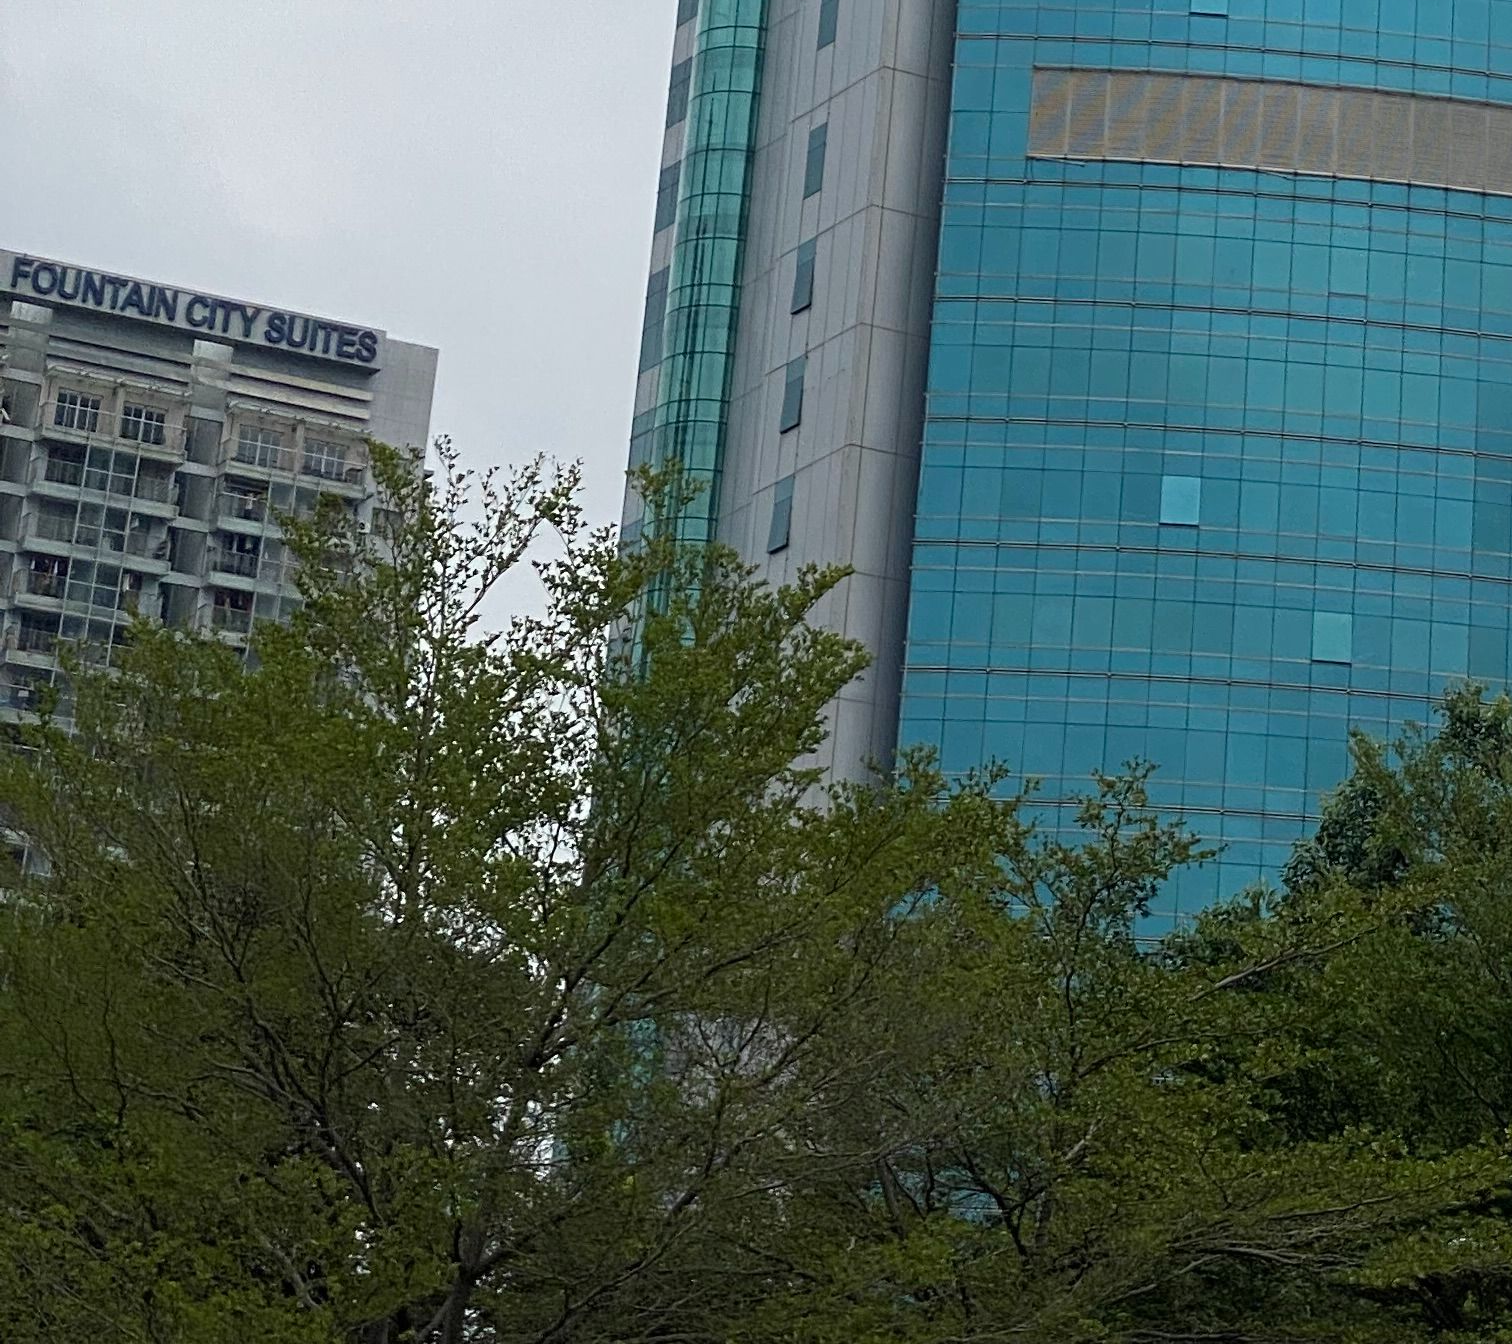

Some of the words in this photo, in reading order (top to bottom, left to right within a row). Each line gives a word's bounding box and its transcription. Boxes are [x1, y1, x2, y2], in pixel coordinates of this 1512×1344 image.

[11, 257, 178, 321] FOUNTAIN
[186, 296, 261, 338] CITY
[264, 312, 378, 363] SUITES
